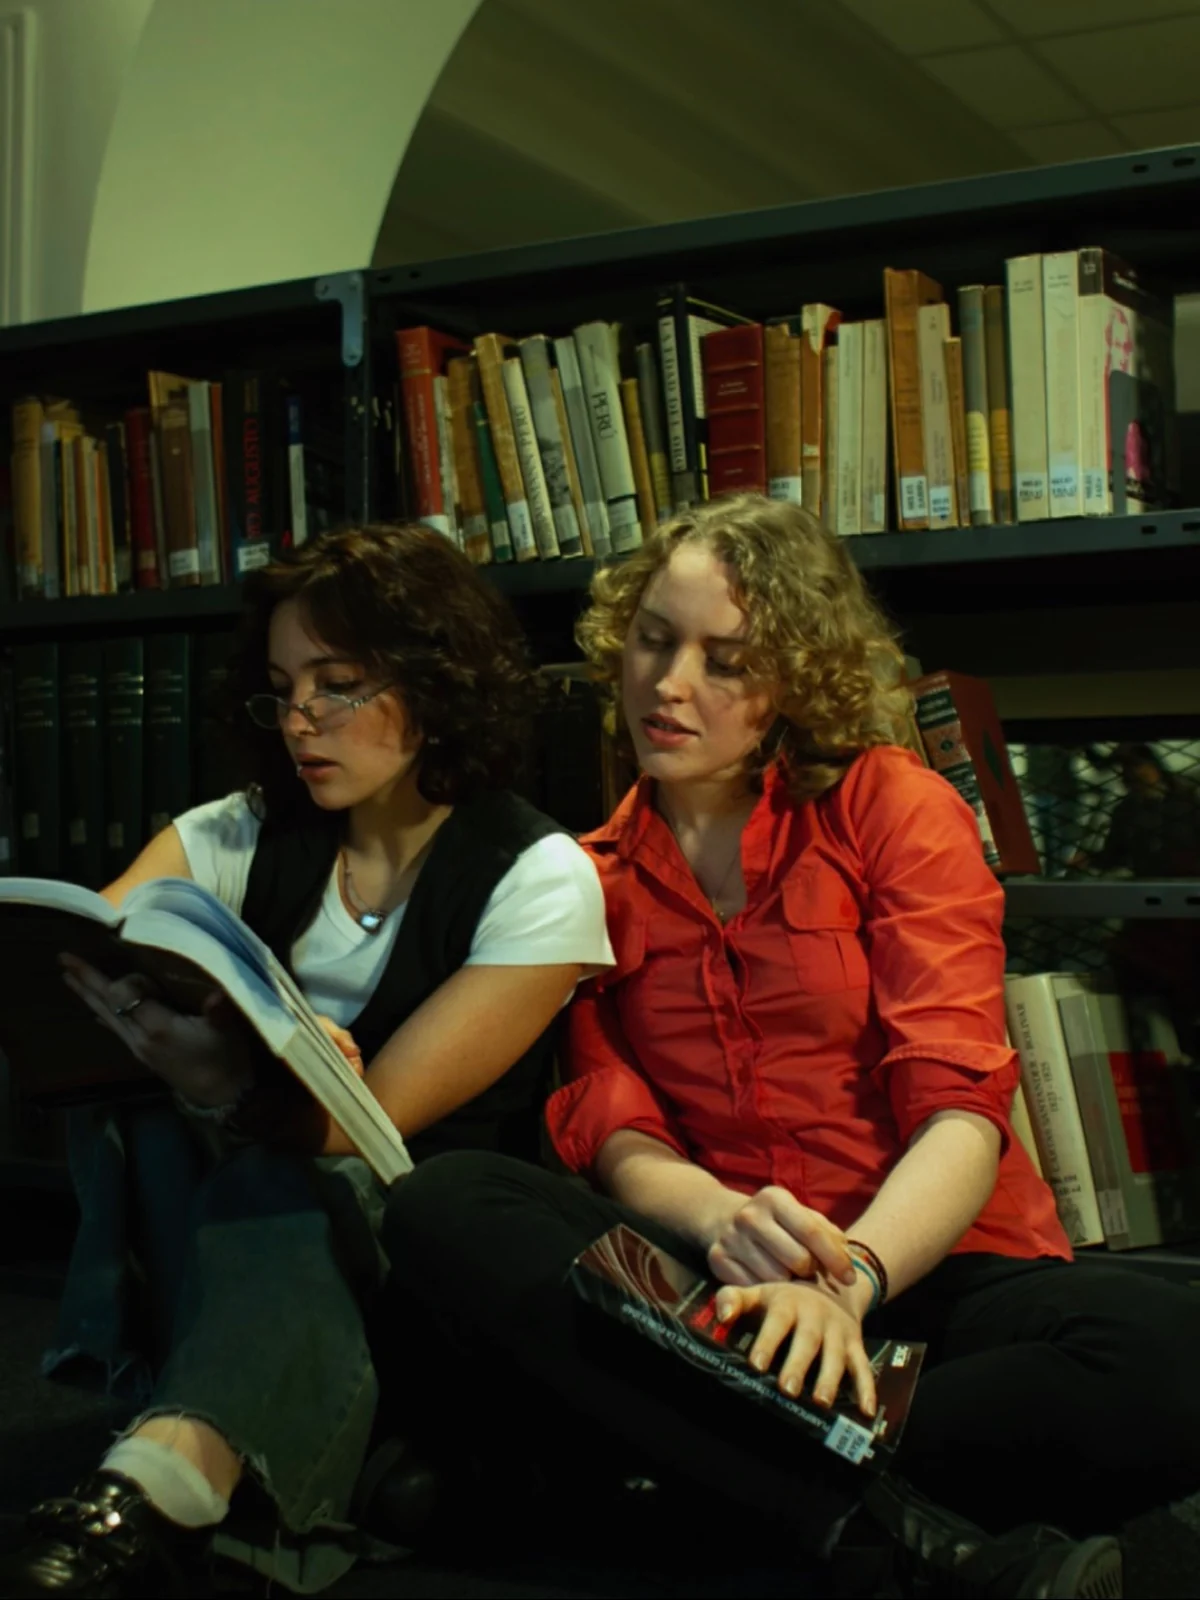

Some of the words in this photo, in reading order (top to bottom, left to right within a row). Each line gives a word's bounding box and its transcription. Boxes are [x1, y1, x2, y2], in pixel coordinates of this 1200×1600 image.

[591, 390, 618, 441] PERÚ
[242, 416, 260, 504] AUGUSTO
[1028, 1059, 1051, 1127] SANTANDER
